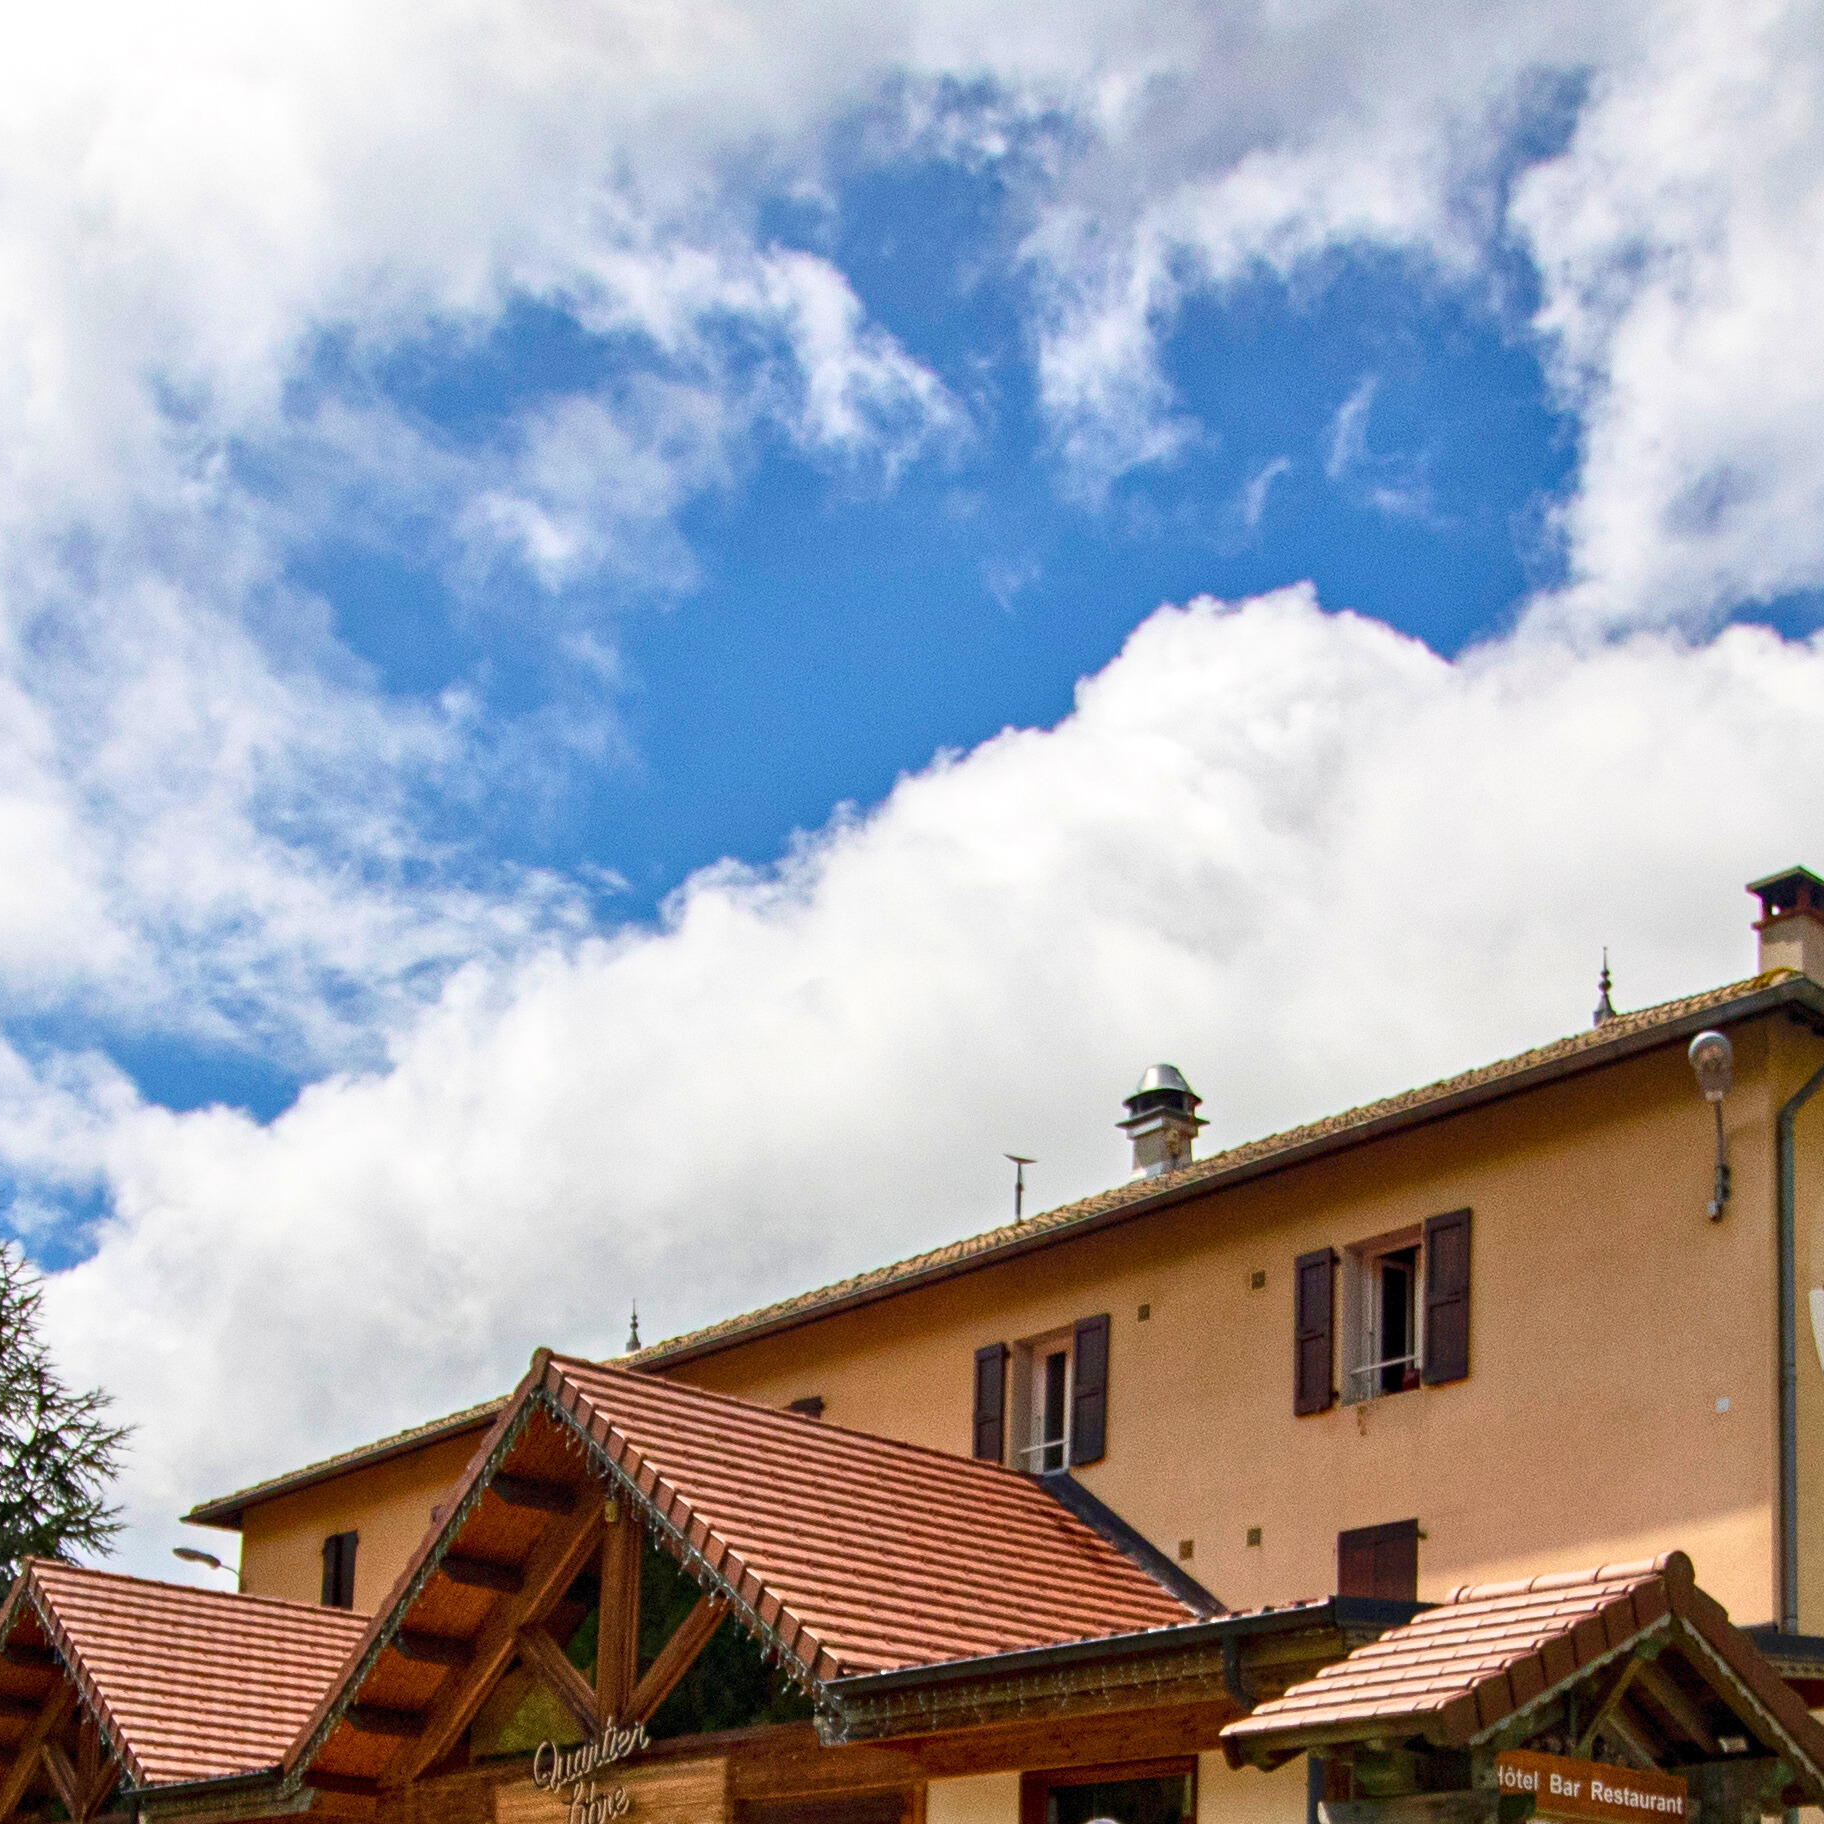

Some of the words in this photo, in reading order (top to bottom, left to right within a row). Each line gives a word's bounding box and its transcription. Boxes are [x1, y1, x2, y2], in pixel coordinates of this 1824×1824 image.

[533, 1715, 650, 1793] Quartier
[1549, 1773, 1581, 1798] Bar
[1590, 1780, 1684, 1815] Restaurant
